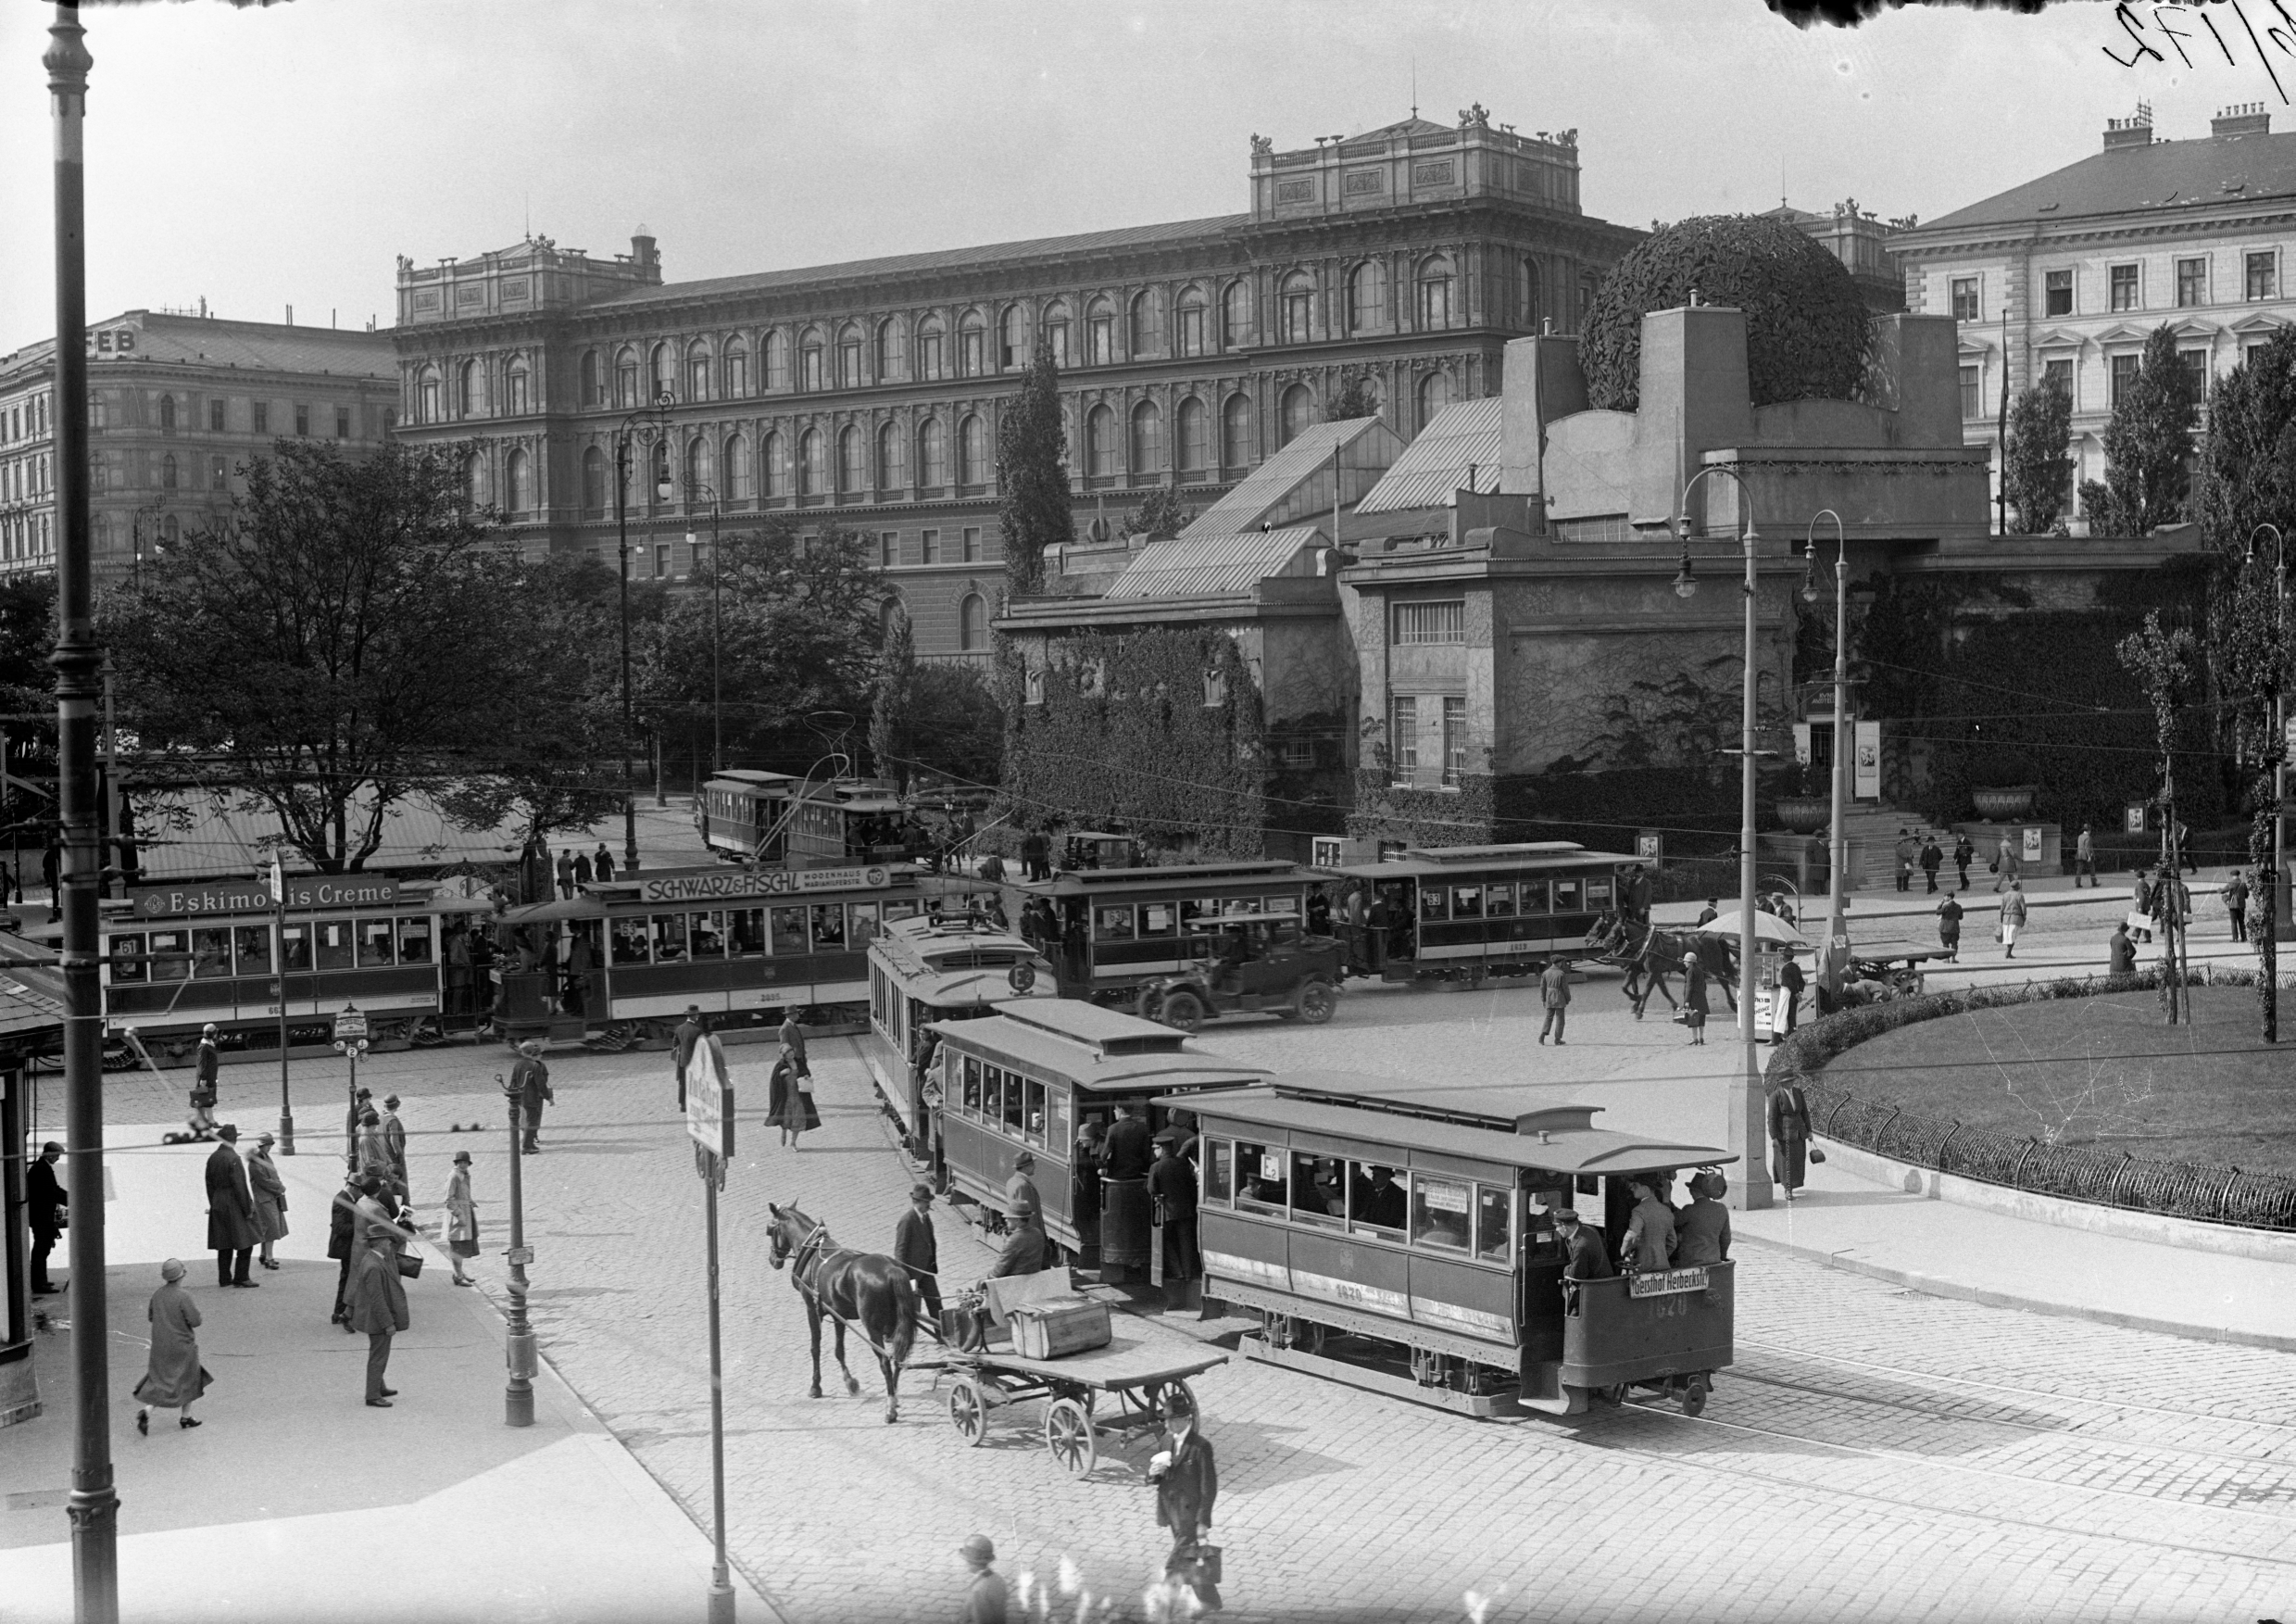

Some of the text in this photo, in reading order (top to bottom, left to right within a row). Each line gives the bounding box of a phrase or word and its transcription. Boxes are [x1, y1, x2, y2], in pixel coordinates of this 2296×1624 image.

[804, 870, 861, 879] MODENHAUS
[170, 892, 267, 913] Eskimo
[319, 885, 393, 903] Creme
[1428, 894, 1440, 904] 63
[122, 941, 134, 954] 61
[1014, 967, 1032, 988] E2
[350, 1048, 355, 1056] 2
[1263, 1155, 1277, 1179] E2
[1336, 1283, 1362, 1303] 1670
[1634, 1274, 1666, 1295] Gersthof
